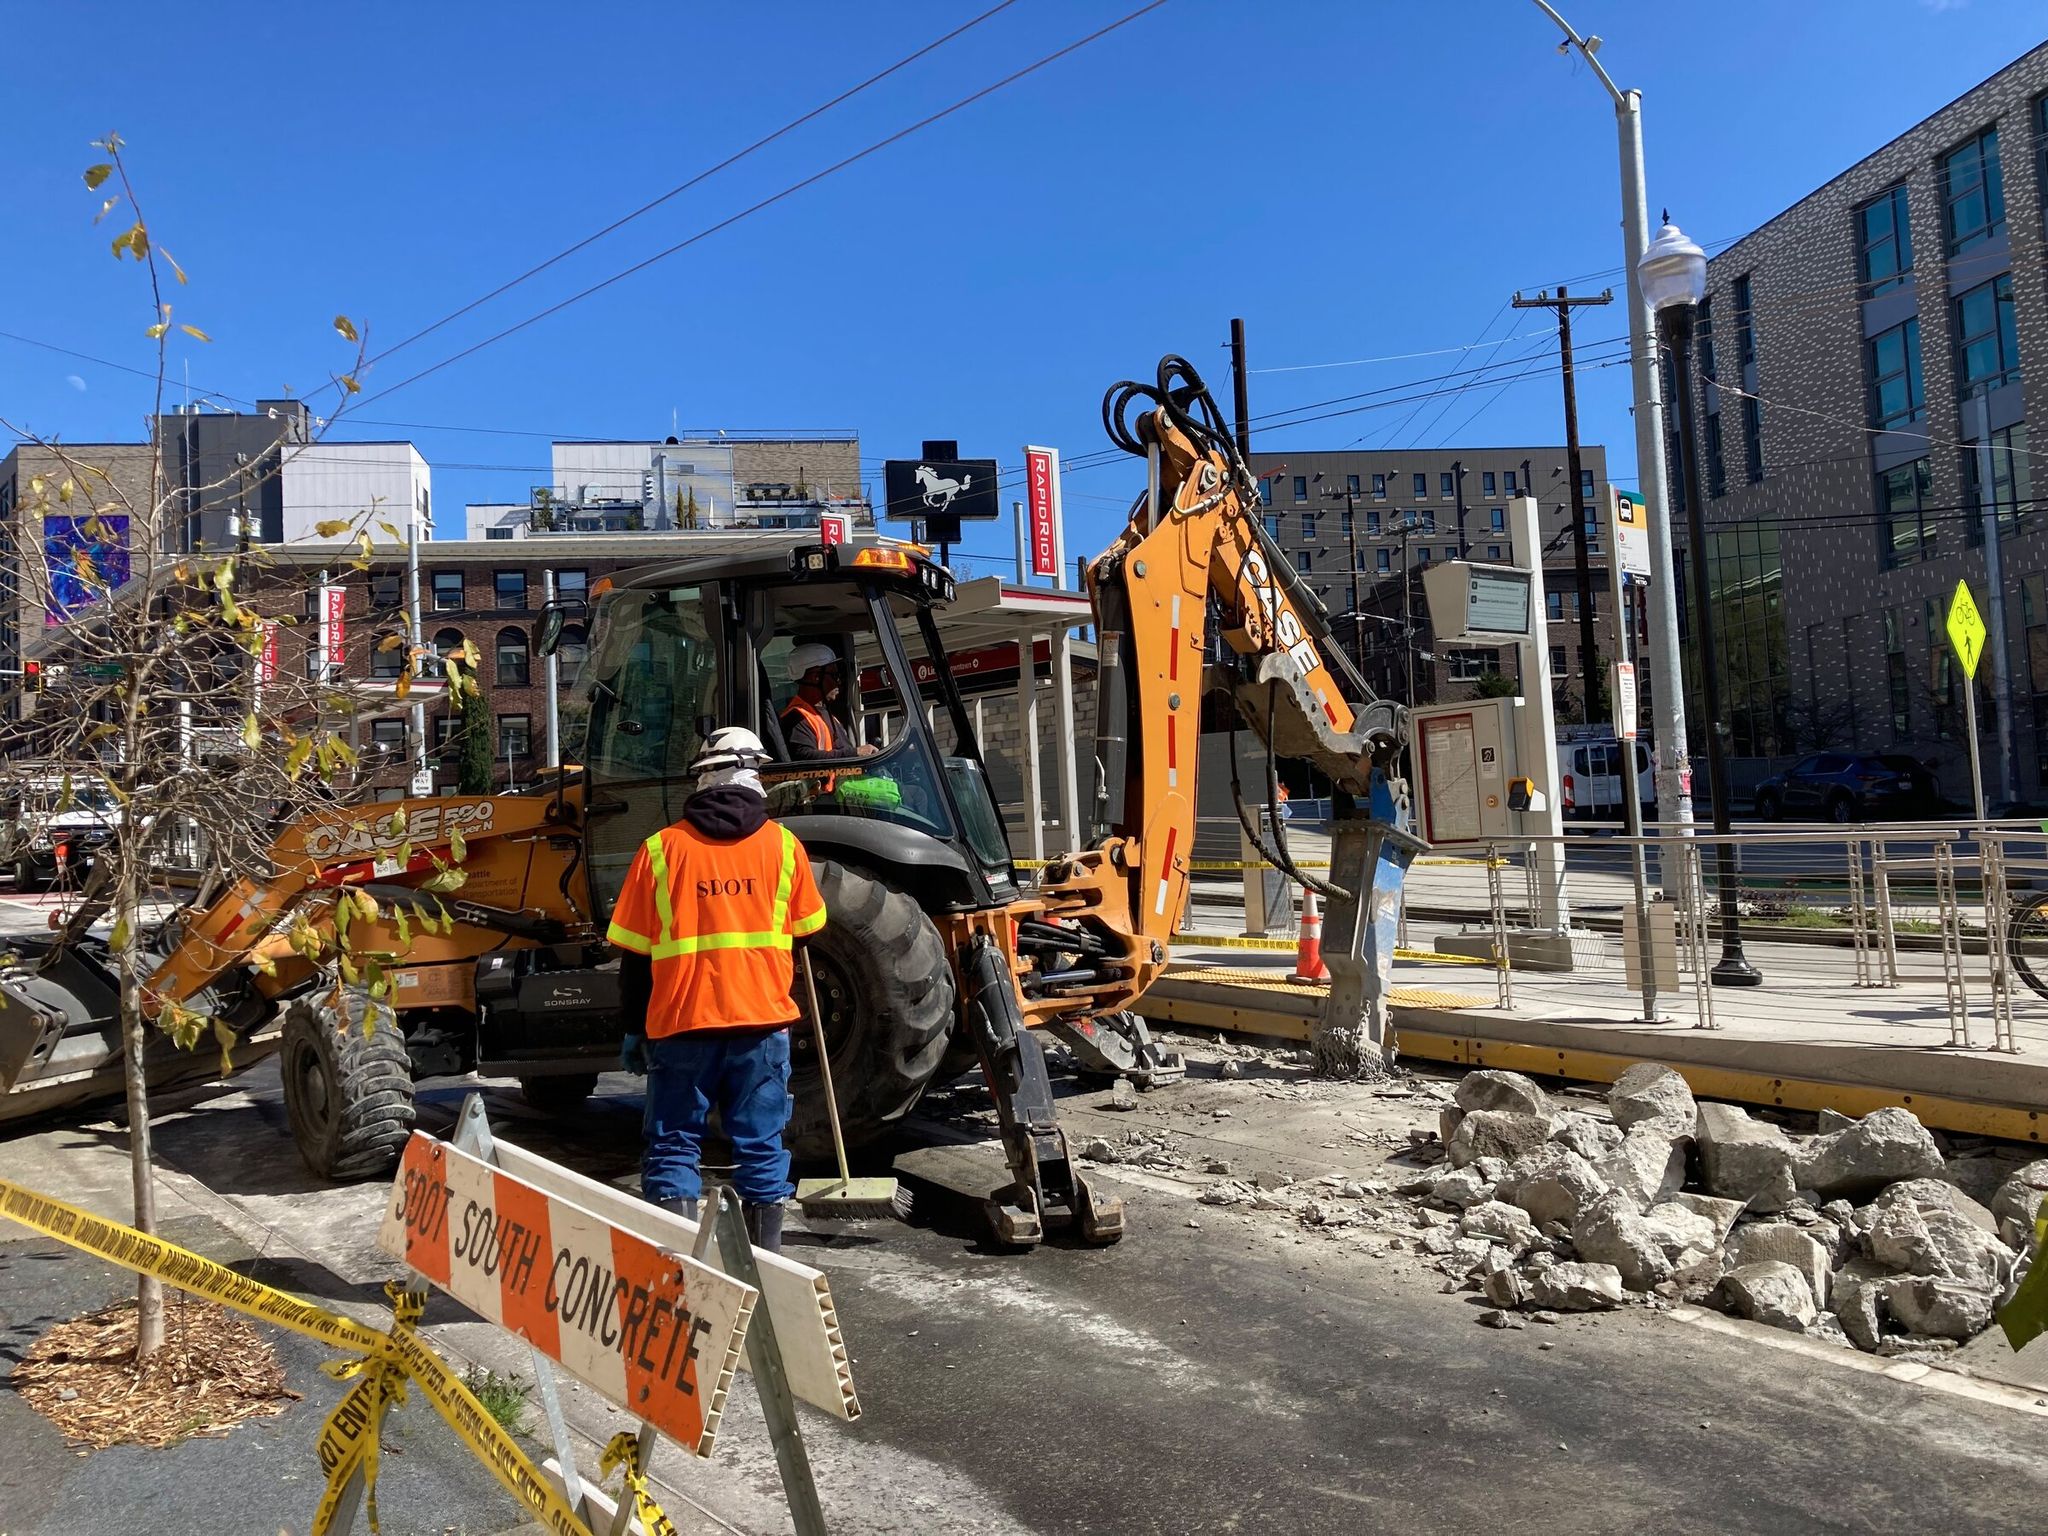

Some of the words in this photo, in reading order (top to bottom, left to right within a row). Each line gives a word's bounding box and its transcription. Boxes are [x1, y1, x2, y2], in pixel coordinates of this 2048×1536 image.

[1035, 457, 1050, 570] RAPIDRIDE
[330, 592, 341, 661] RAPDRIDE
[1242, 549, 1321, 676] CASE
[758, 769, 833, 782] ONSTRUCTION
[835, 767, 862, 777] KING
[305, 805, 442, 861] CASE
[467, 870, 490, 879] eattle
[696, 878, 756, 898] SDOT
[543, 998, 592, 1007] SONSRAY
[74, 1216, 109, 1250] CAUTION
[101, 1227, 121, 1254] DO
[113, 1231, 138, 1260] NOT
[130, 1237, 162, 1269] ENTER
[157, 1248, 200, 1285] CAUTION
[192, 1261, 213, 1288] DO
[205, 1266, 233, 1296] NOT
[223, 1275, 264, 1306] ENTER
[258, 1291, 306, 1322] CAUTION
[395, 1167, 455, 1243] SDOT
[455, 1200, 541, 1295] SOUTH
[544, 1247, 713, 1396] CONCRETE
[332, 1377, 376, 1440] ENTE
